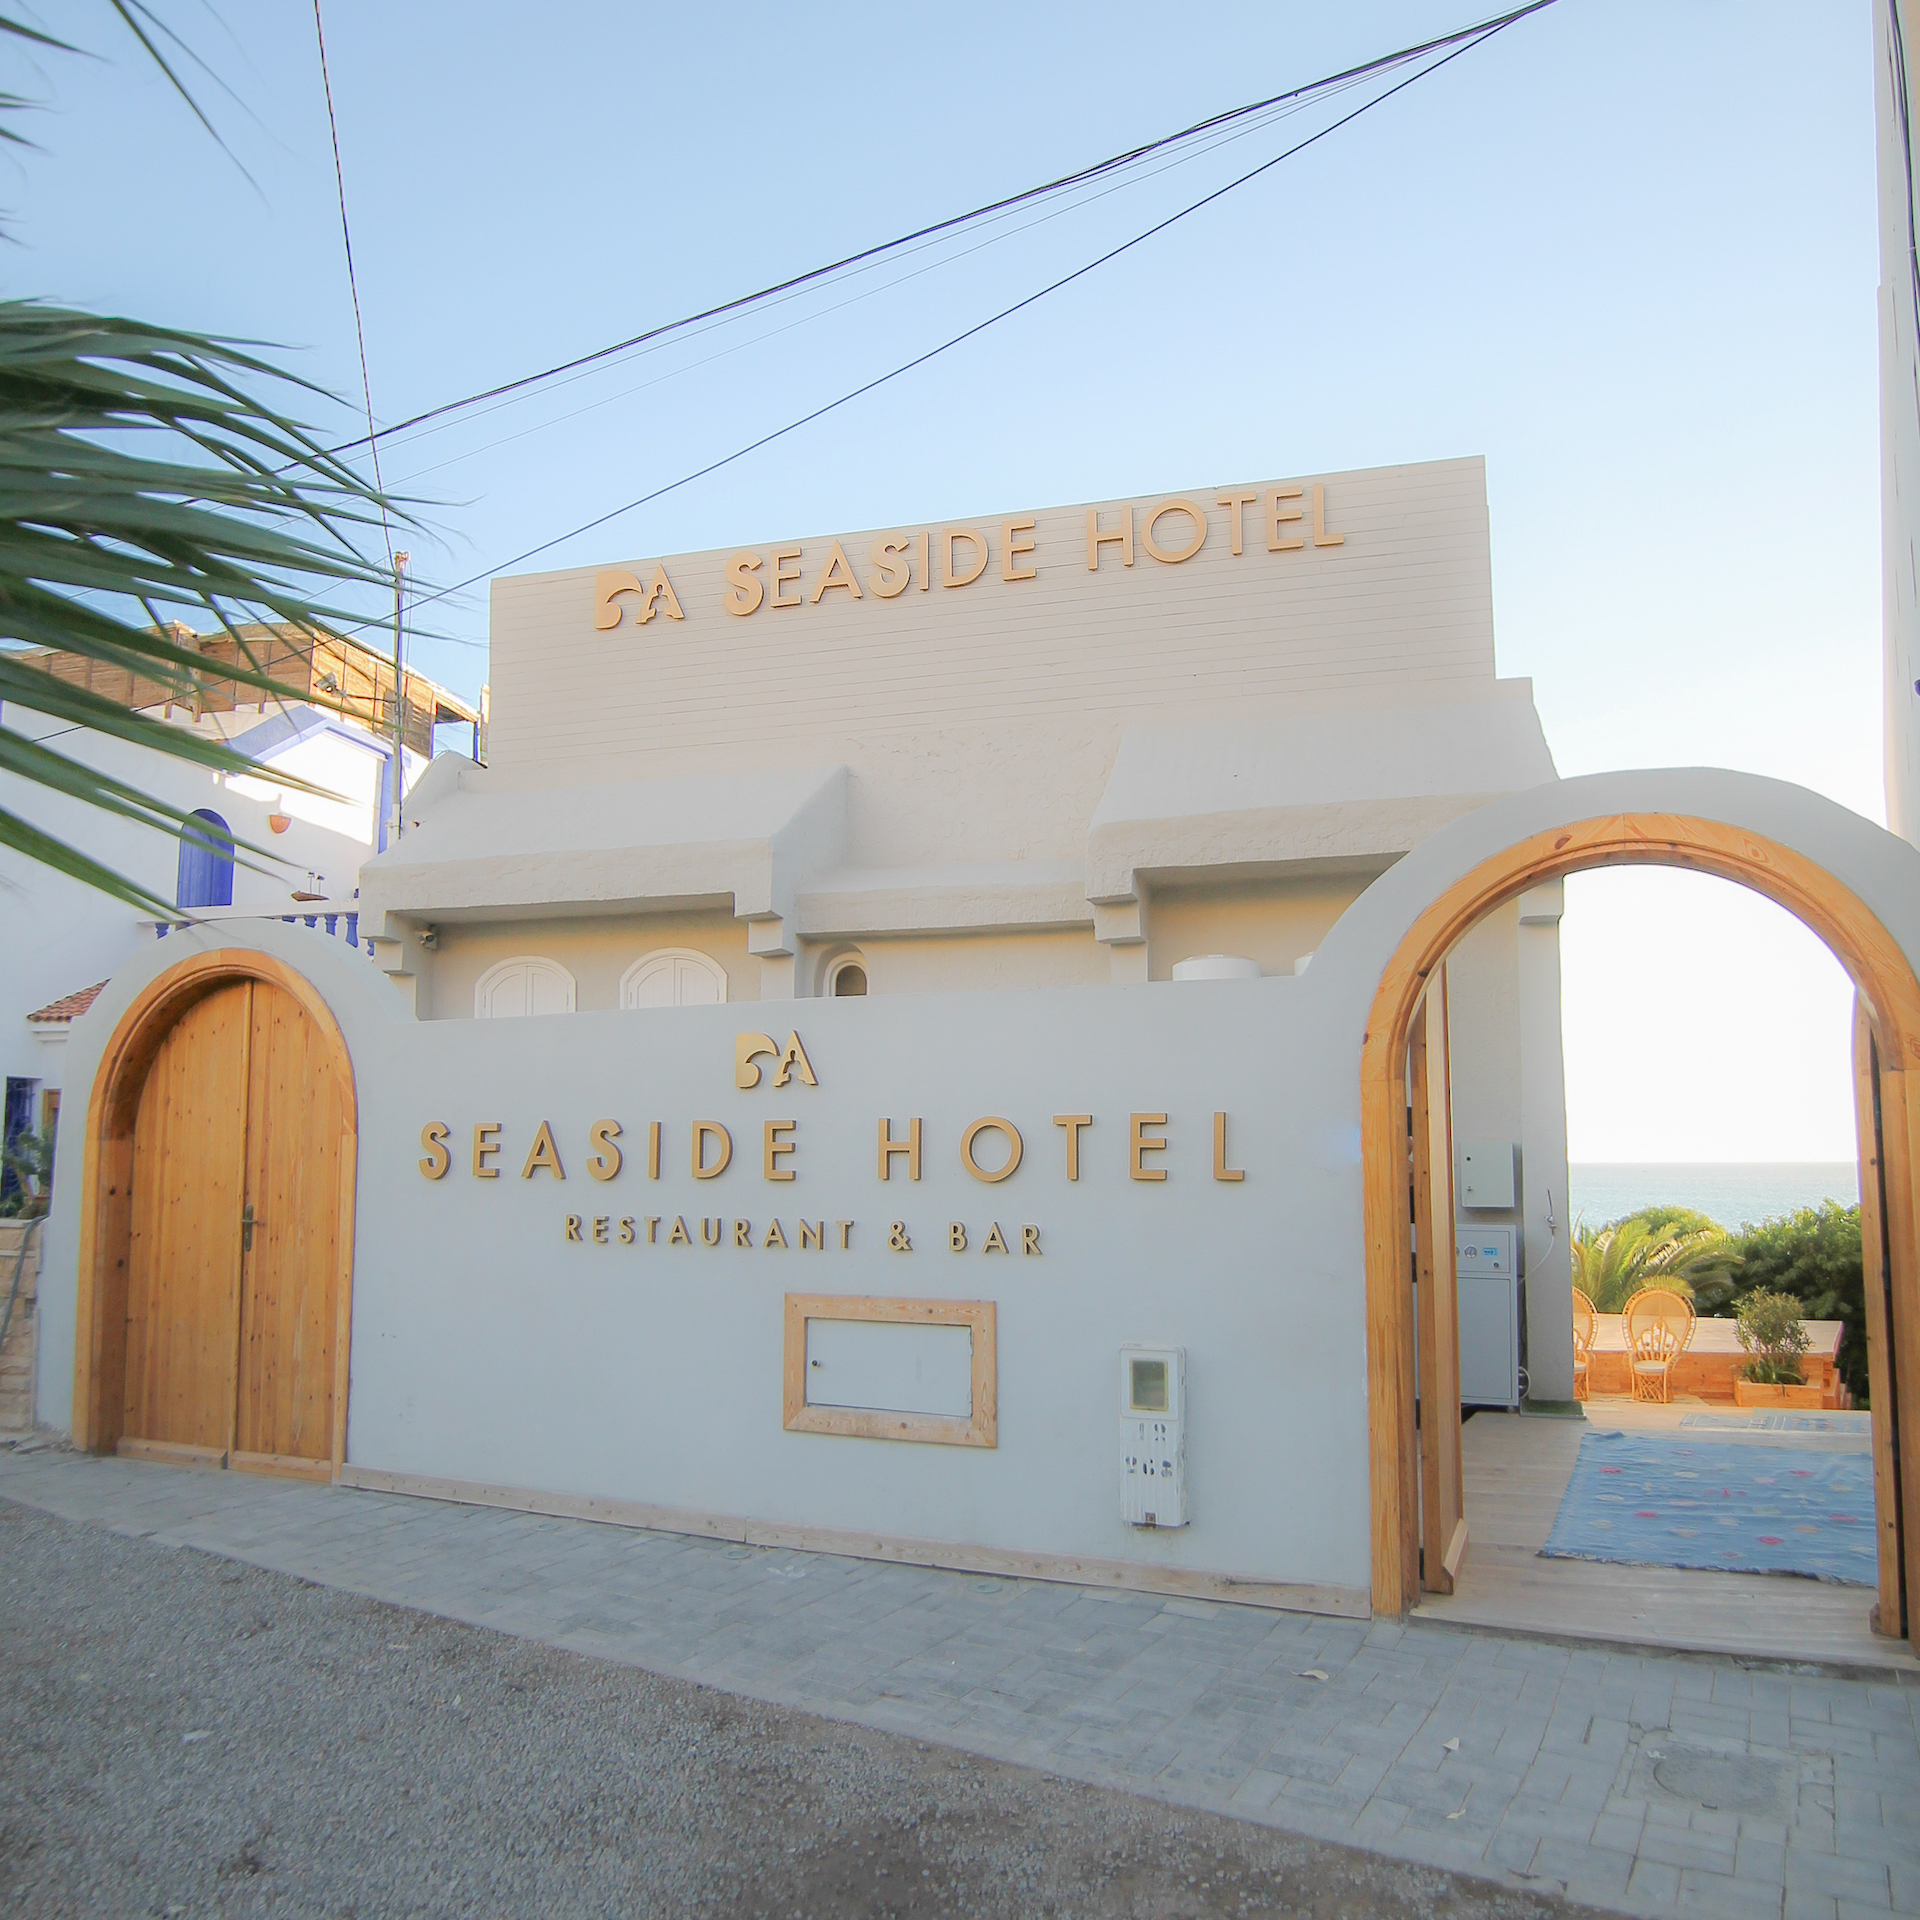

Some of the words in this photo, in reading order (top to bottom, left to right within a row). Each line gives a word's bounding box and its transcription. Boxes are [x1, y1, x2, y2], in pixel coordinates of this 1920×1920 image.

[723, 518, 1036, 617] SEASIDE
[1088, 482, 1345, 571] HOTEL
[418, 1118, 797, 1181] SEASIDE
[878, 1111, 1245, 1182] HOTEL
[566, 1214, 855, 1250] RESTAURANT
[887, 1219, 912, 1252] &
[948, 1221, 1045, 1255] BAR
